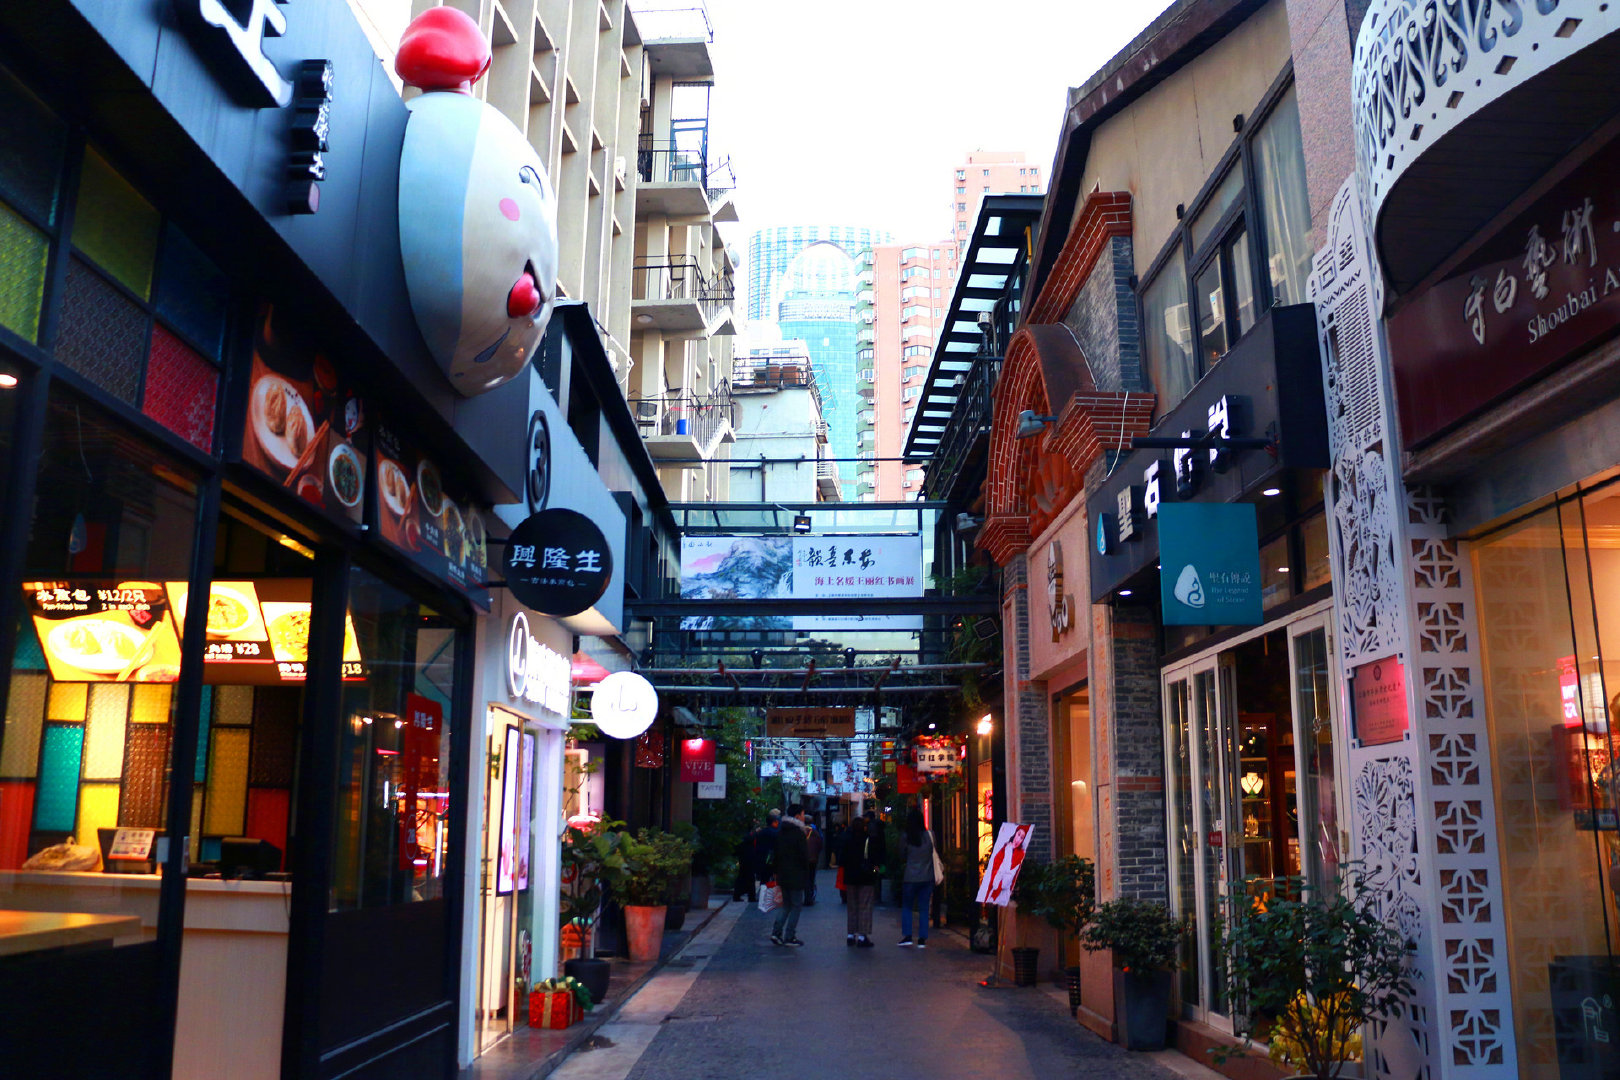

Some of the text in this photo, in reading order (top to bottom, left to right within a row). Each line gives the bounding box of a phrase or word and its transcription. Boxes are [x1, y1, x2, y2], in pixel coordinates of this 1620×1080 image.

[1527, 266, 1620, 345] Shoubai A
[509, 544, 602, 573] 興隆生
[685, 761, 712, 771] VIVE
